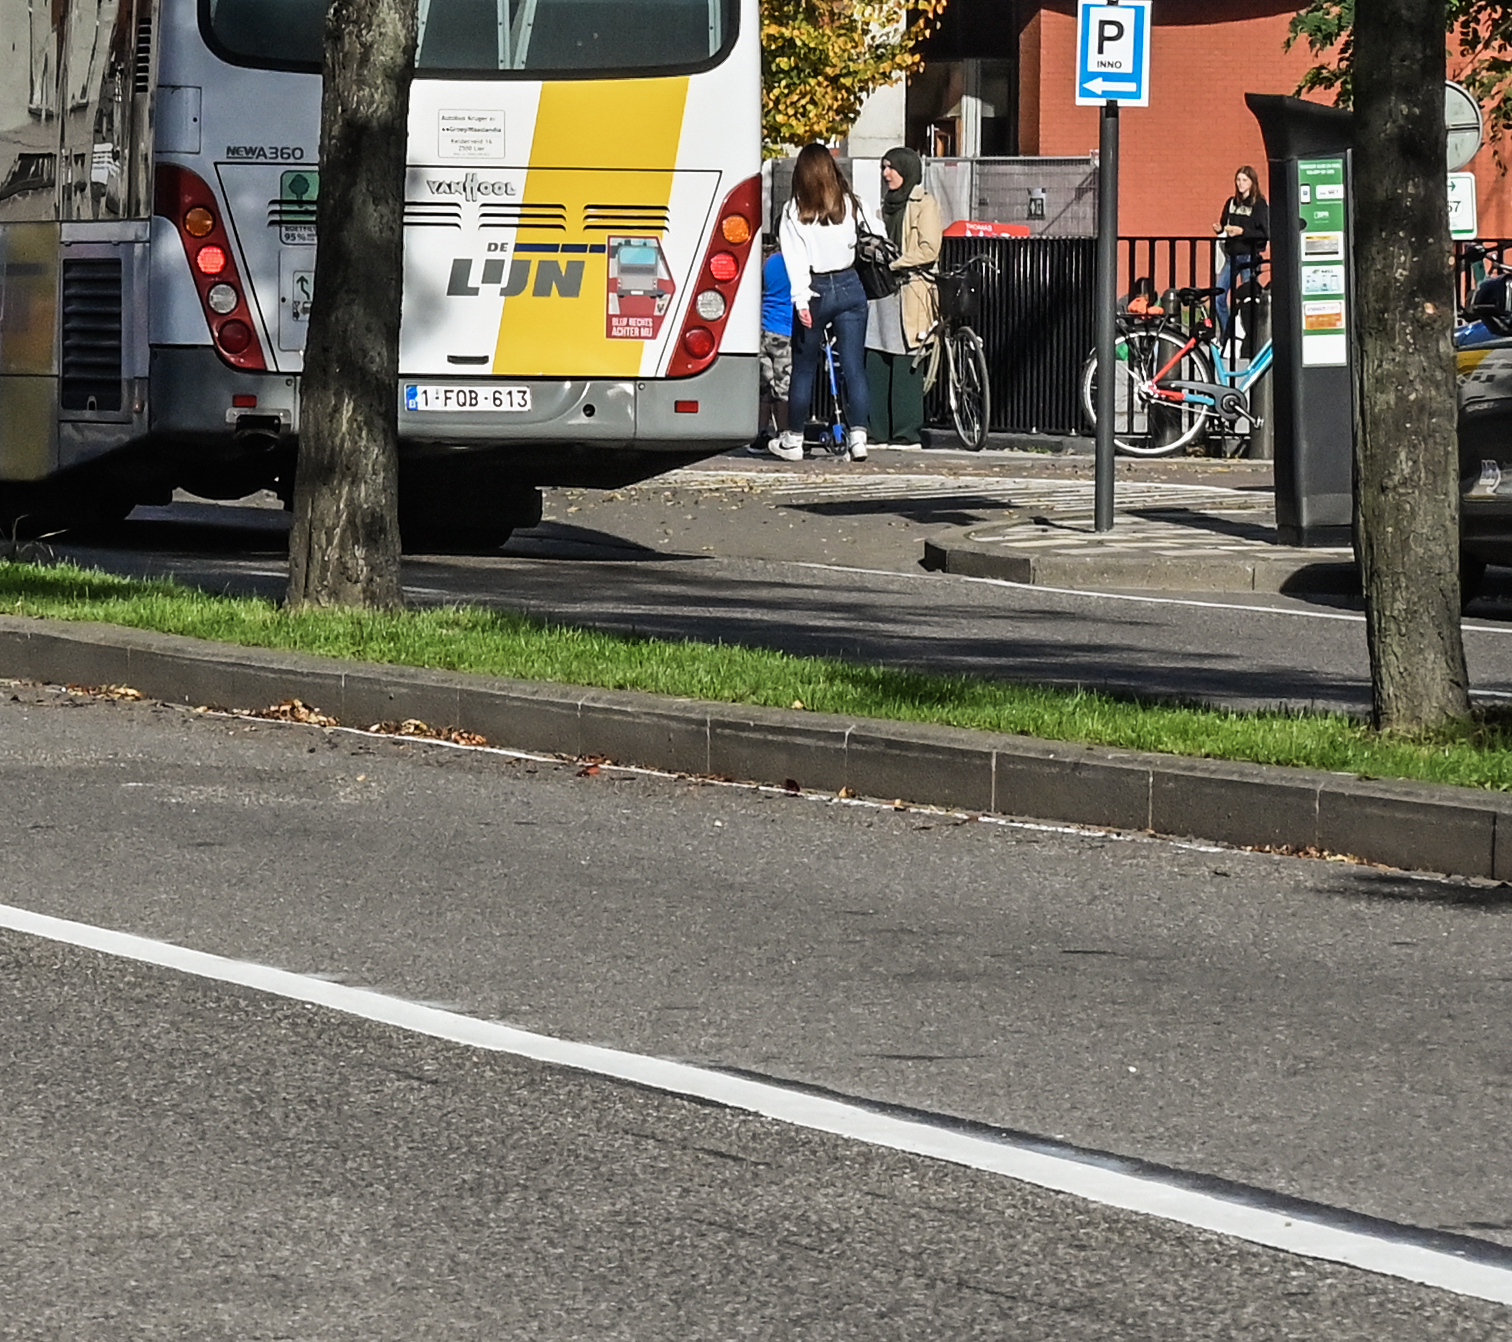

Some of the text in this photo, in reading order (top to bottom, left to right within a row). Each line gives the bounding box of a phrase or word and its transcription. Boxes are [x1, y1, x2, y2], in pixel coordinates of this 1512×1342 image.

[1097, 19, 1125, 55] P
[1097, 60, 1123, 69] INNO
[965, 222, 993, 232] THOMAS
[486, 242, 509, 252] DE
[446, 258, 586, 297] LIJN
[611, 326, 640, 337] ACHTER
[421, 389, 528, 408] 1-FQB-613
